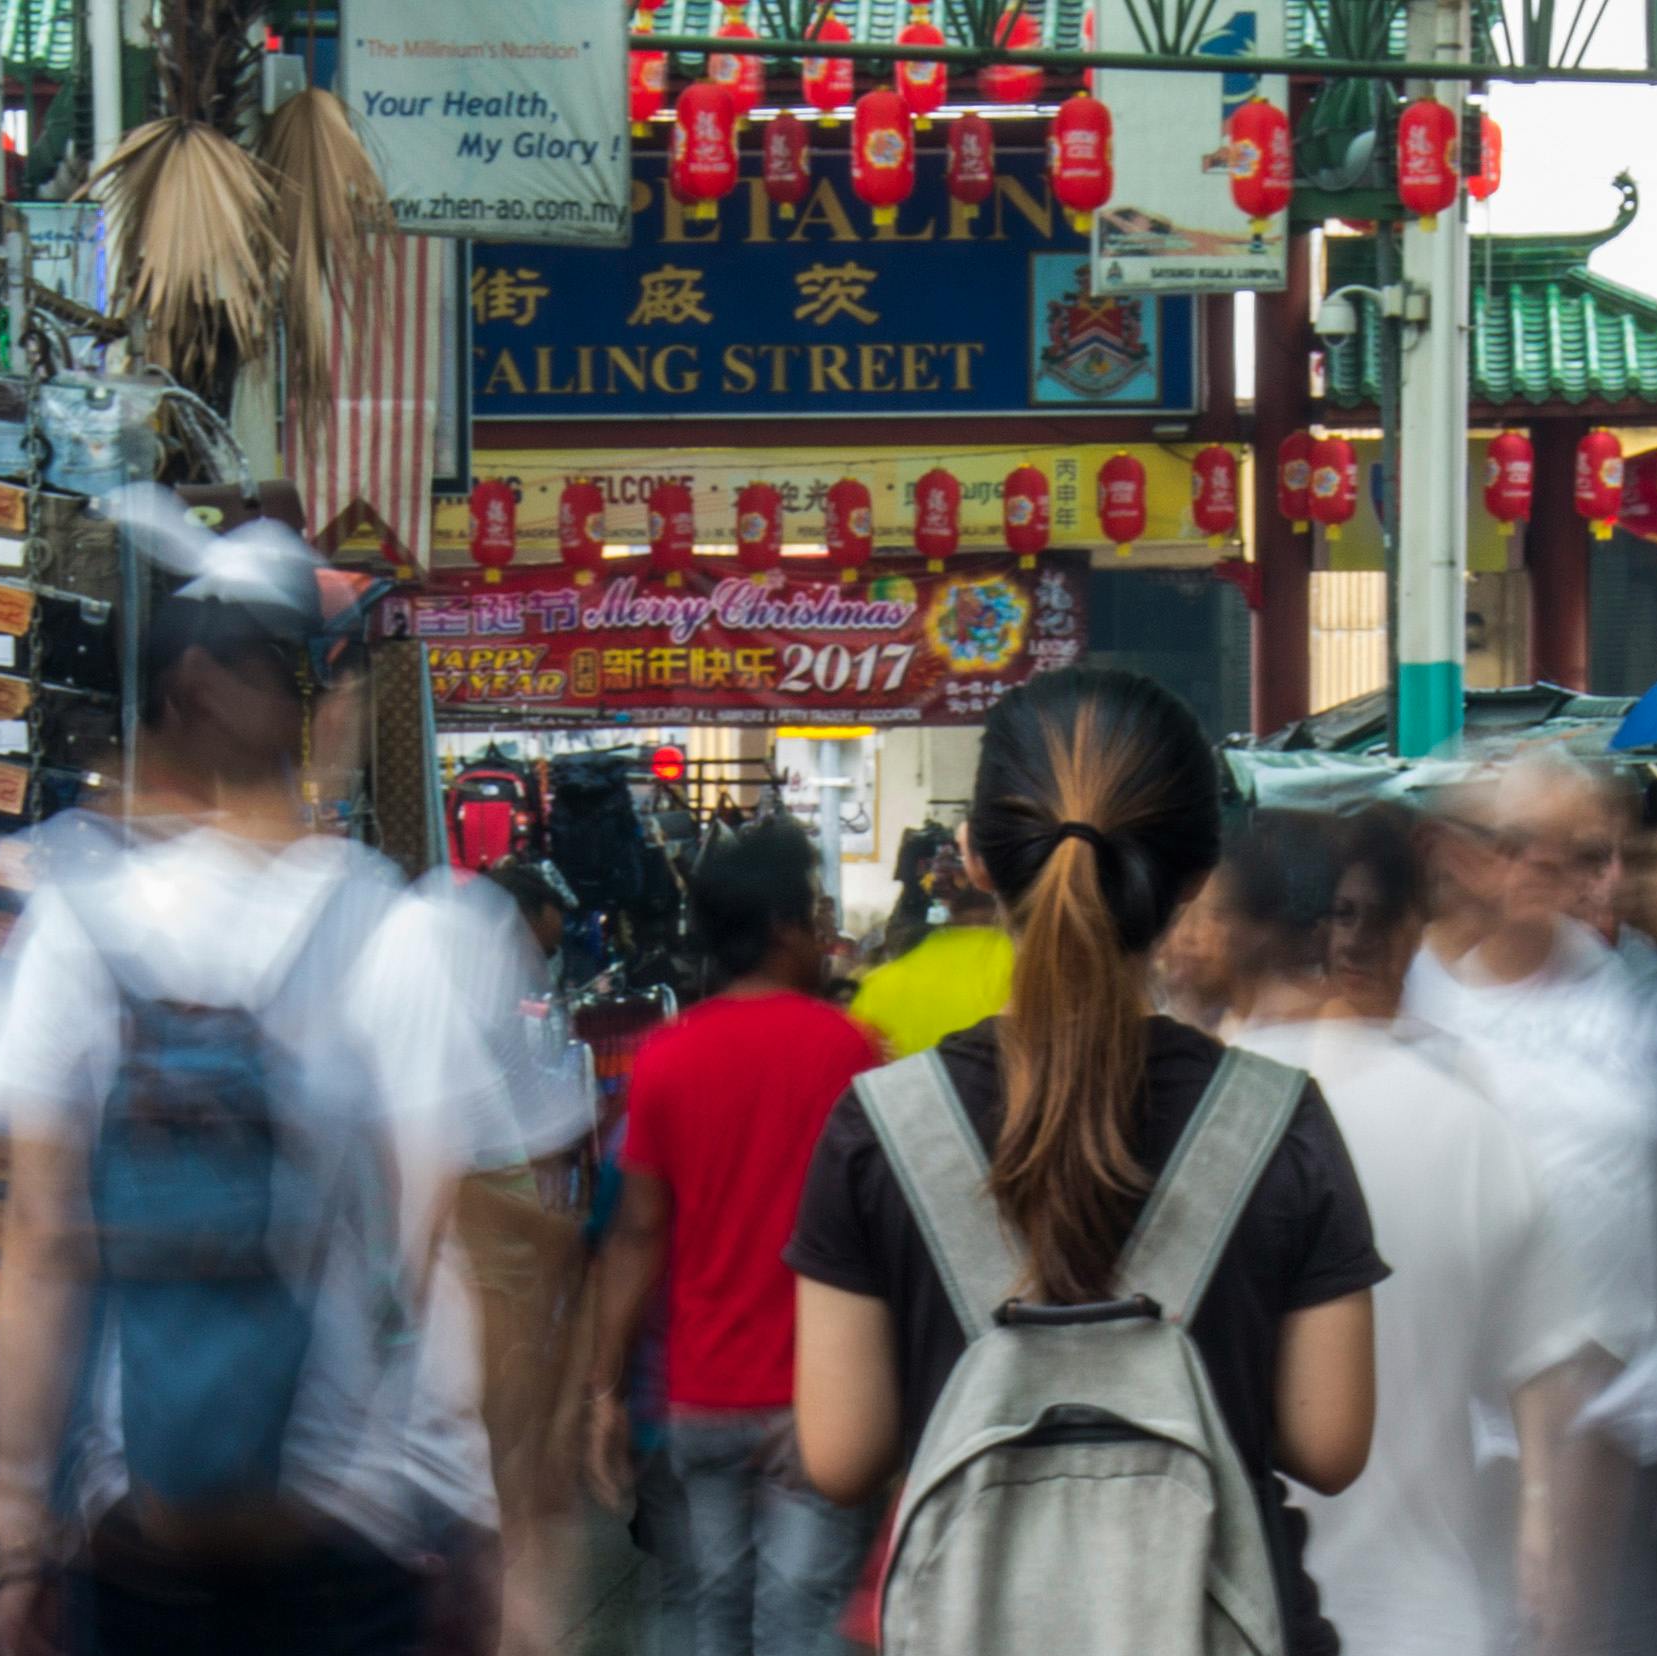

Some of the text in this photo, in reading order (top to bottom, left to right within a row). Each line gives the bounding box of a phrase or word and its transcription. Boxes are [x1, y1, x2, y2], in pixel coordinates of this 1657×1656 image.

[362, 90, 558, 123] Your Health,
[456, 132, 502, 163] My
[513, 132, 598, 165] Glory
[723, 343, 984, 394] STREET
[415, 588, 581, 637] 圣诞节
[582, 574, 919, 645] Merry Christmas
[468, 669, 566, 700] YEAR
[602, 647, 777, 691] 新年快乐
[777, 643, 917, 694] 2017
